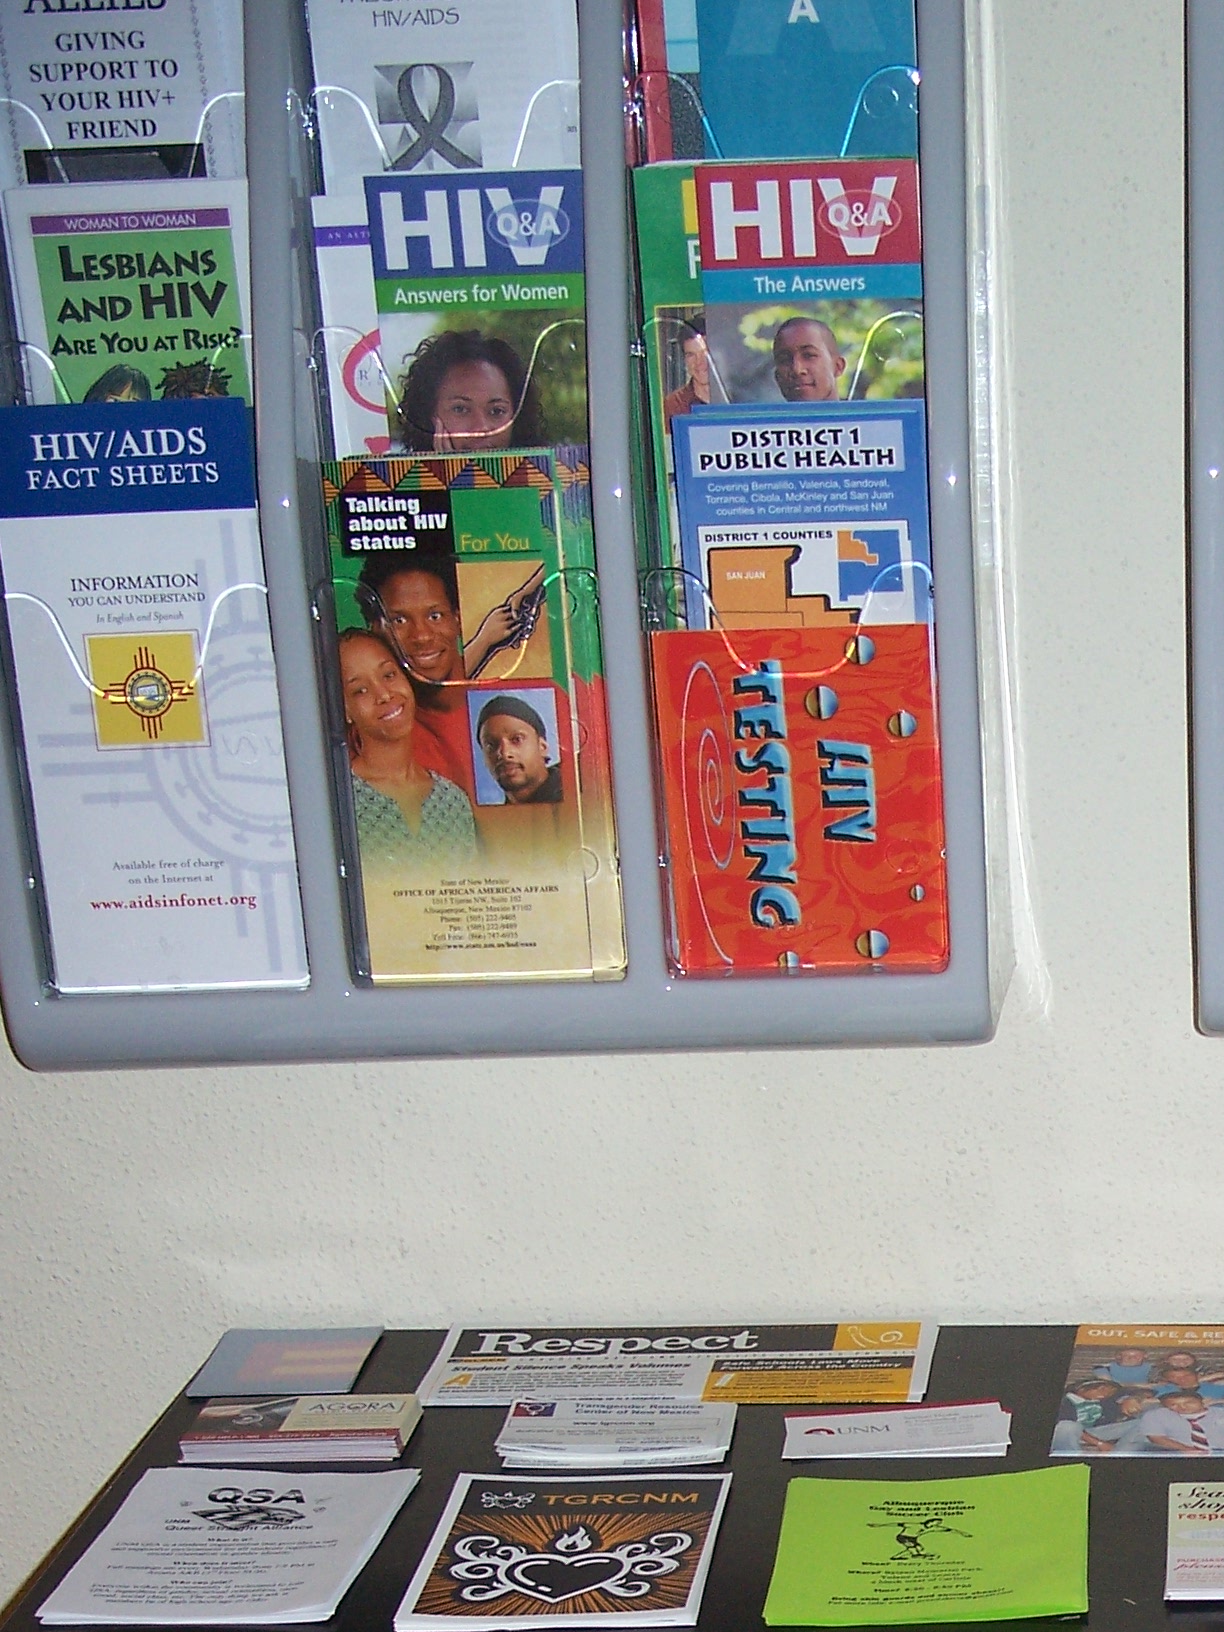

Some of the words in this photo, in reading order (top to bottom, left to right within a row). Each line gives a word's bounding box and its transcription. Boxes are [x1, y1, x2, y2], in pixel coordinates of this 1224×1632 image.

[55, 31, 146, 52] GIVING
[29, 61, 138, 82] SUPPORT
[145, 59, 178, 79] TO
[40, 92, 111, 112] YOUR
[117, 89, 176, 109] HIV+
[67, 118, 157, 140] FRIEND
[65, 216, 119, 231] WOMAN
[121, 216, 139, 229] TO
[141, 213, 197, 228] WOMAN
[495, 210, 561, 237] Q&A
[710, 176, 897, 260] HIV
[826, 202, 893, 228] Q&A
[379, 185, 564, 270] HIV
[394, 283, 467, 305] Answers
[472, 283, 498, 302] for
[503, 280, 569, 301] Women
[754, 275, 790, 294] The
[793, 273, 865, 294] Answers
[57, 297, 134, 324] AND
[139, 280, 228, 320] HIV
[153, 335, 179, 352] AT
[31, 426, 208, 463] HIV/AIDS
[731, 428, 840, 449] DISTRICT
[848, 428, 860, 445] 1
[699, 451, 789, 472] PUBLIC
[793, 446, 895, 468] HEALTH
[26, 468, 101, 490] FACT
[110, 461, 220, 486] SHEETS
[346, 497, 419, 515] Talking
[348, 514, 408, 532] about
[414, 514, 449, 532] HIV
[350, 534, 417, 551] status
[460, 534, 489, 551] For
[494, 533, 530, 551] You
[70, 573, 200, 592] INFORMATION
[733, 660, 801, 930] TESTING
[817, 741, 876, 843] HIV
[90, 893, 257, 912] www.aidsinfonet.org
[471, 1329, 759, 1357] Respect
[207, 1486, 306, 1505] QSA
[541, 1490, 700, 1506] TGRCNM
